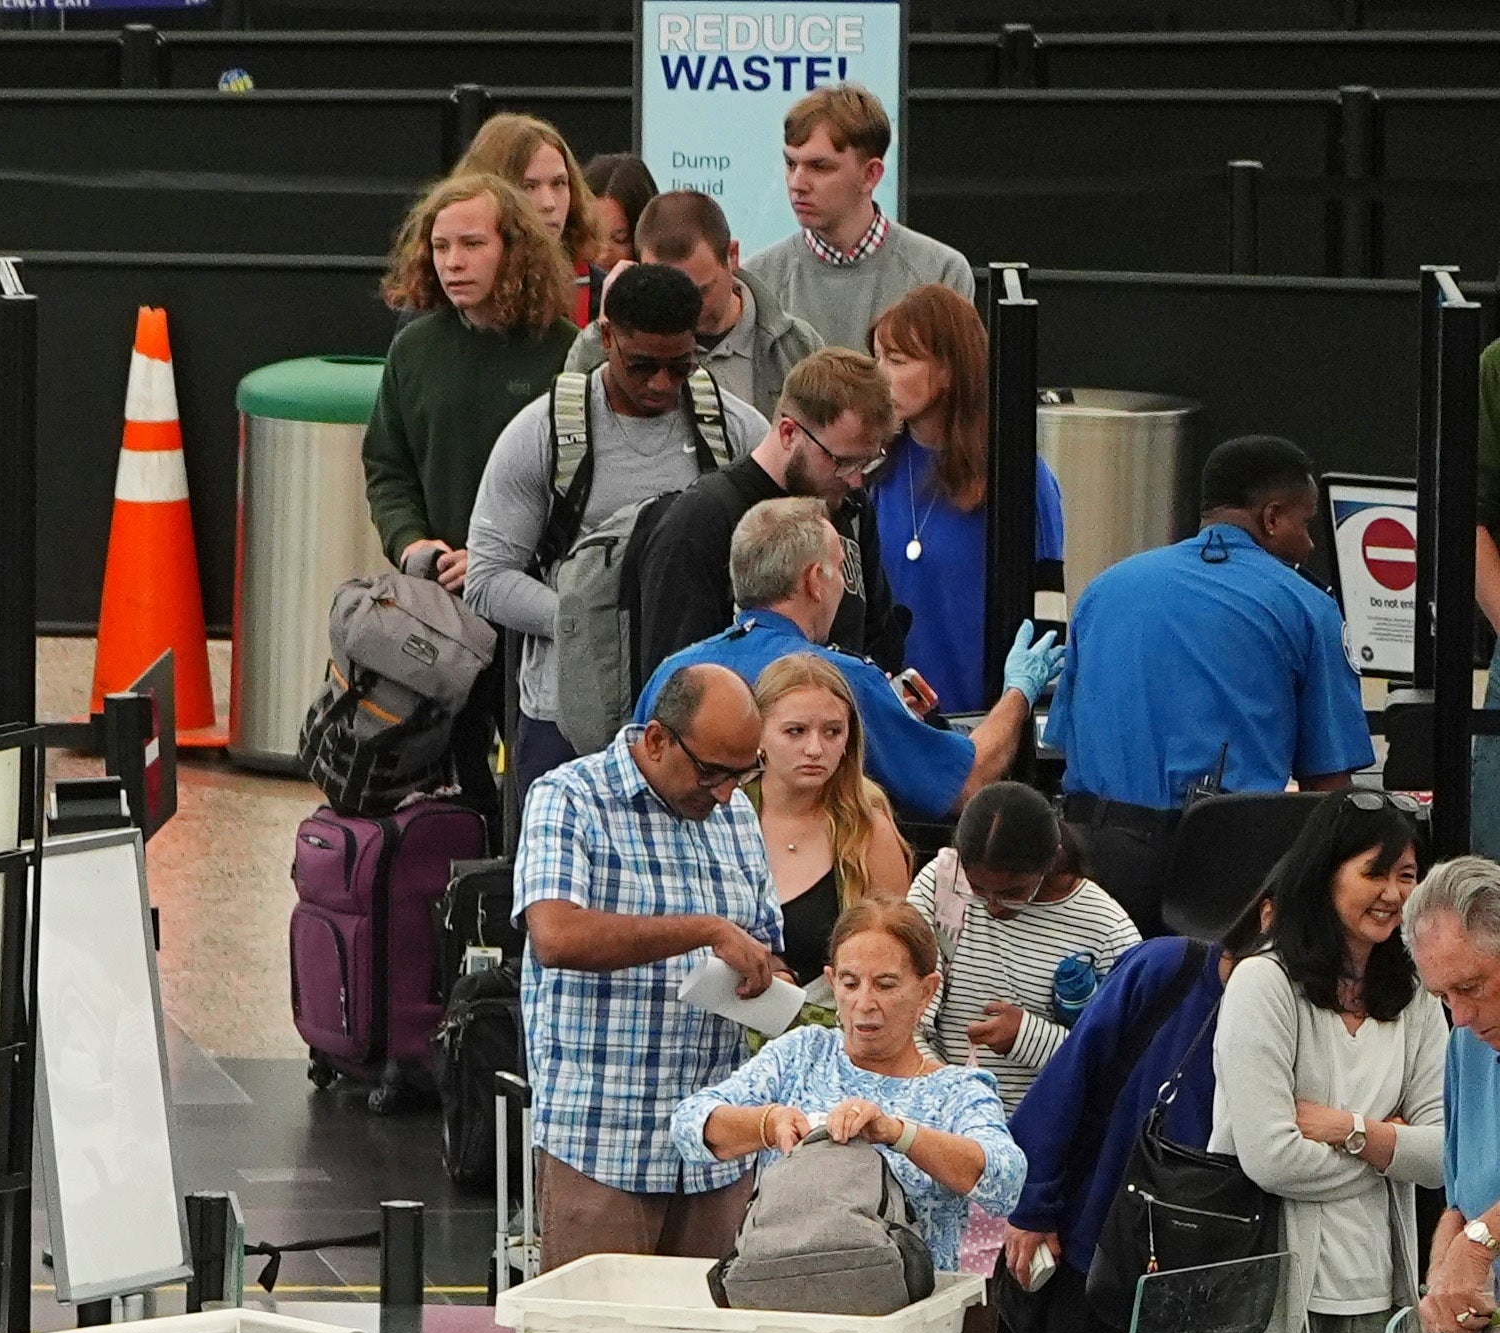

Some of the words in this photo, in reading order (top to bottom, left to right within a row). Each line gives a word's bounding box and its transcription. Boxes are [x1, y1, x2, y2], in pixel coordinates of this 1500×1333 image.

[658, 13, 864, 53] REDUCE
[660, 55, 848, 91] WASTE!
[673, 152, 731, 171] Dump
[1370, 596, 1383, 608] Do
[1401, 600, 1415, 610] ent
